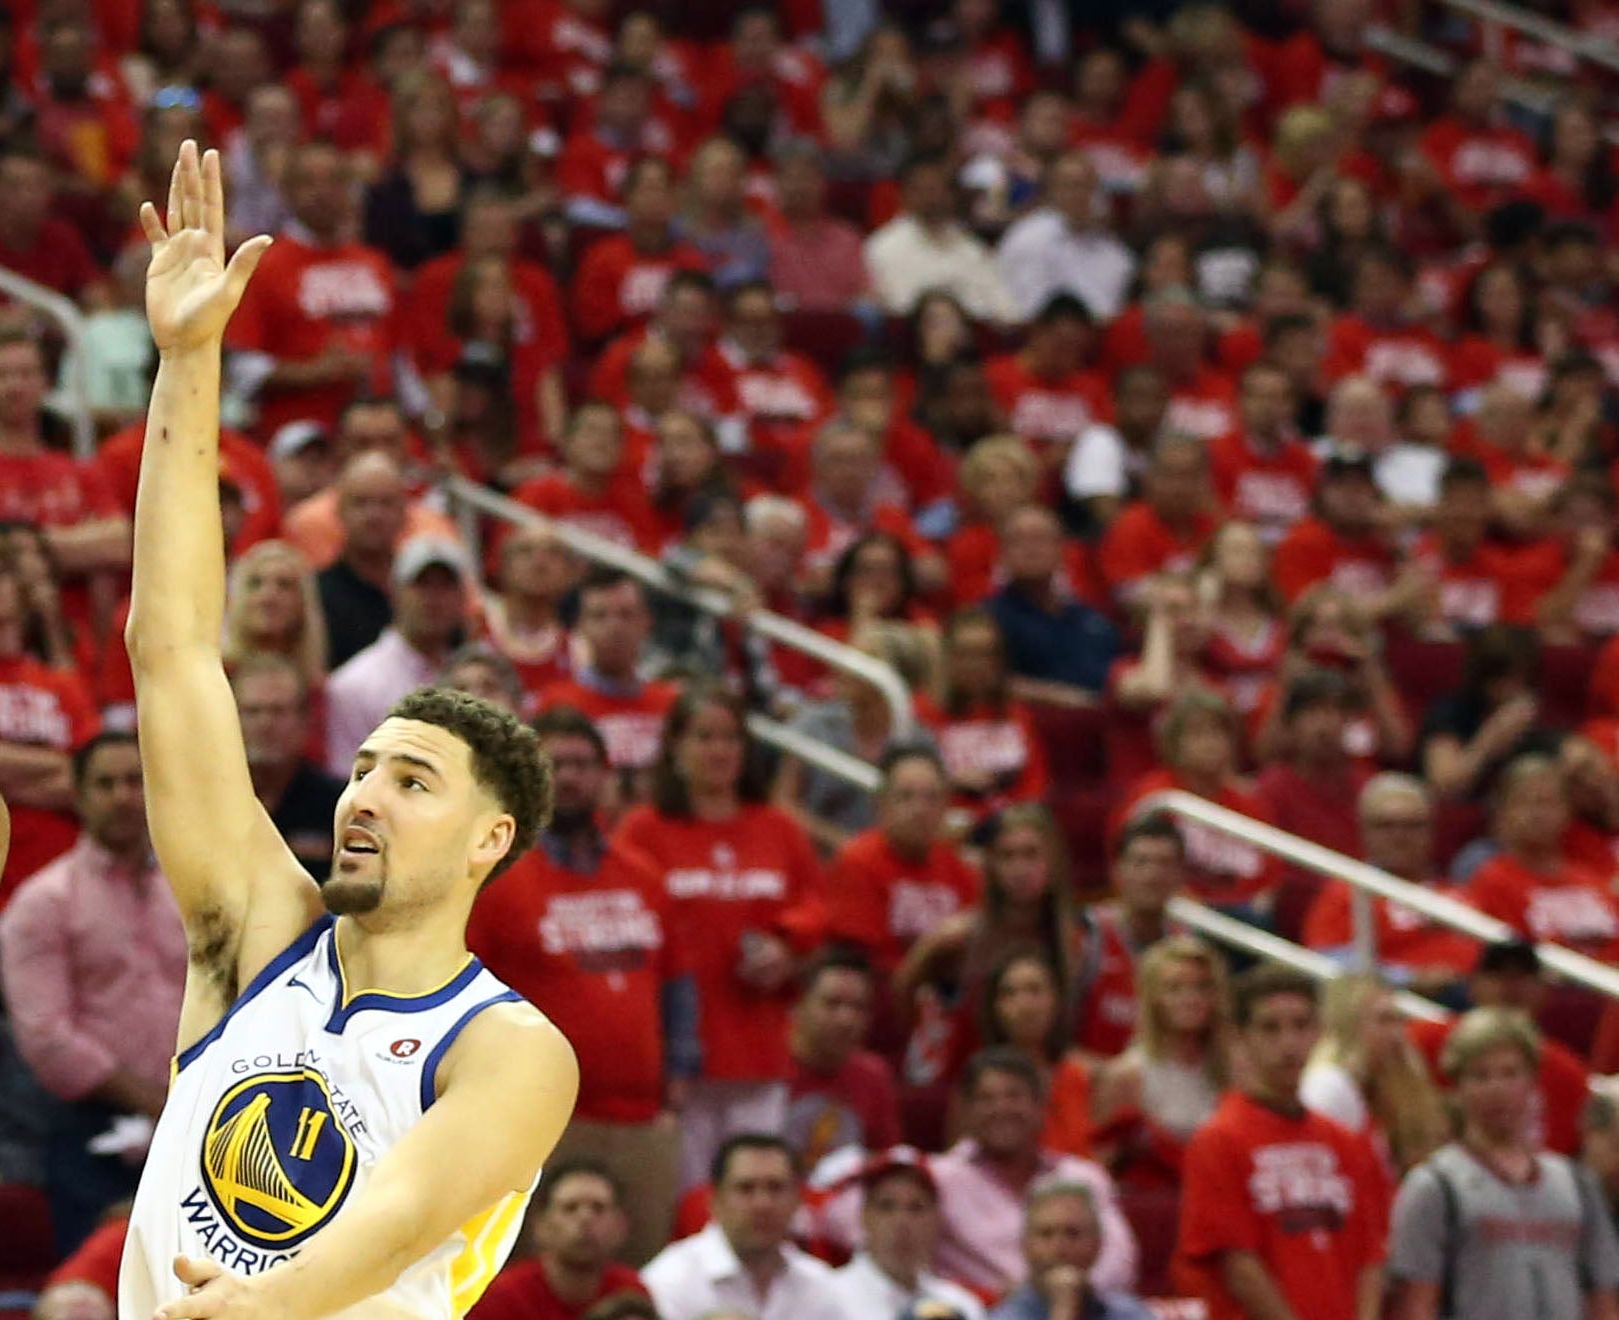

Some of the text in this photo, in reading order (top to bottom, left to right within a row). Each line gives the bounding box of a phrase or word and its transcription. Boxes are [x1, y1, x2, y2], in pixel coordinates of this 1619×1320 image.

[231, 1049, 321, 1073] GOLDN
[289, 1106, 328, 1161] 11
[180, 1186, 301, 1275] WARRI
